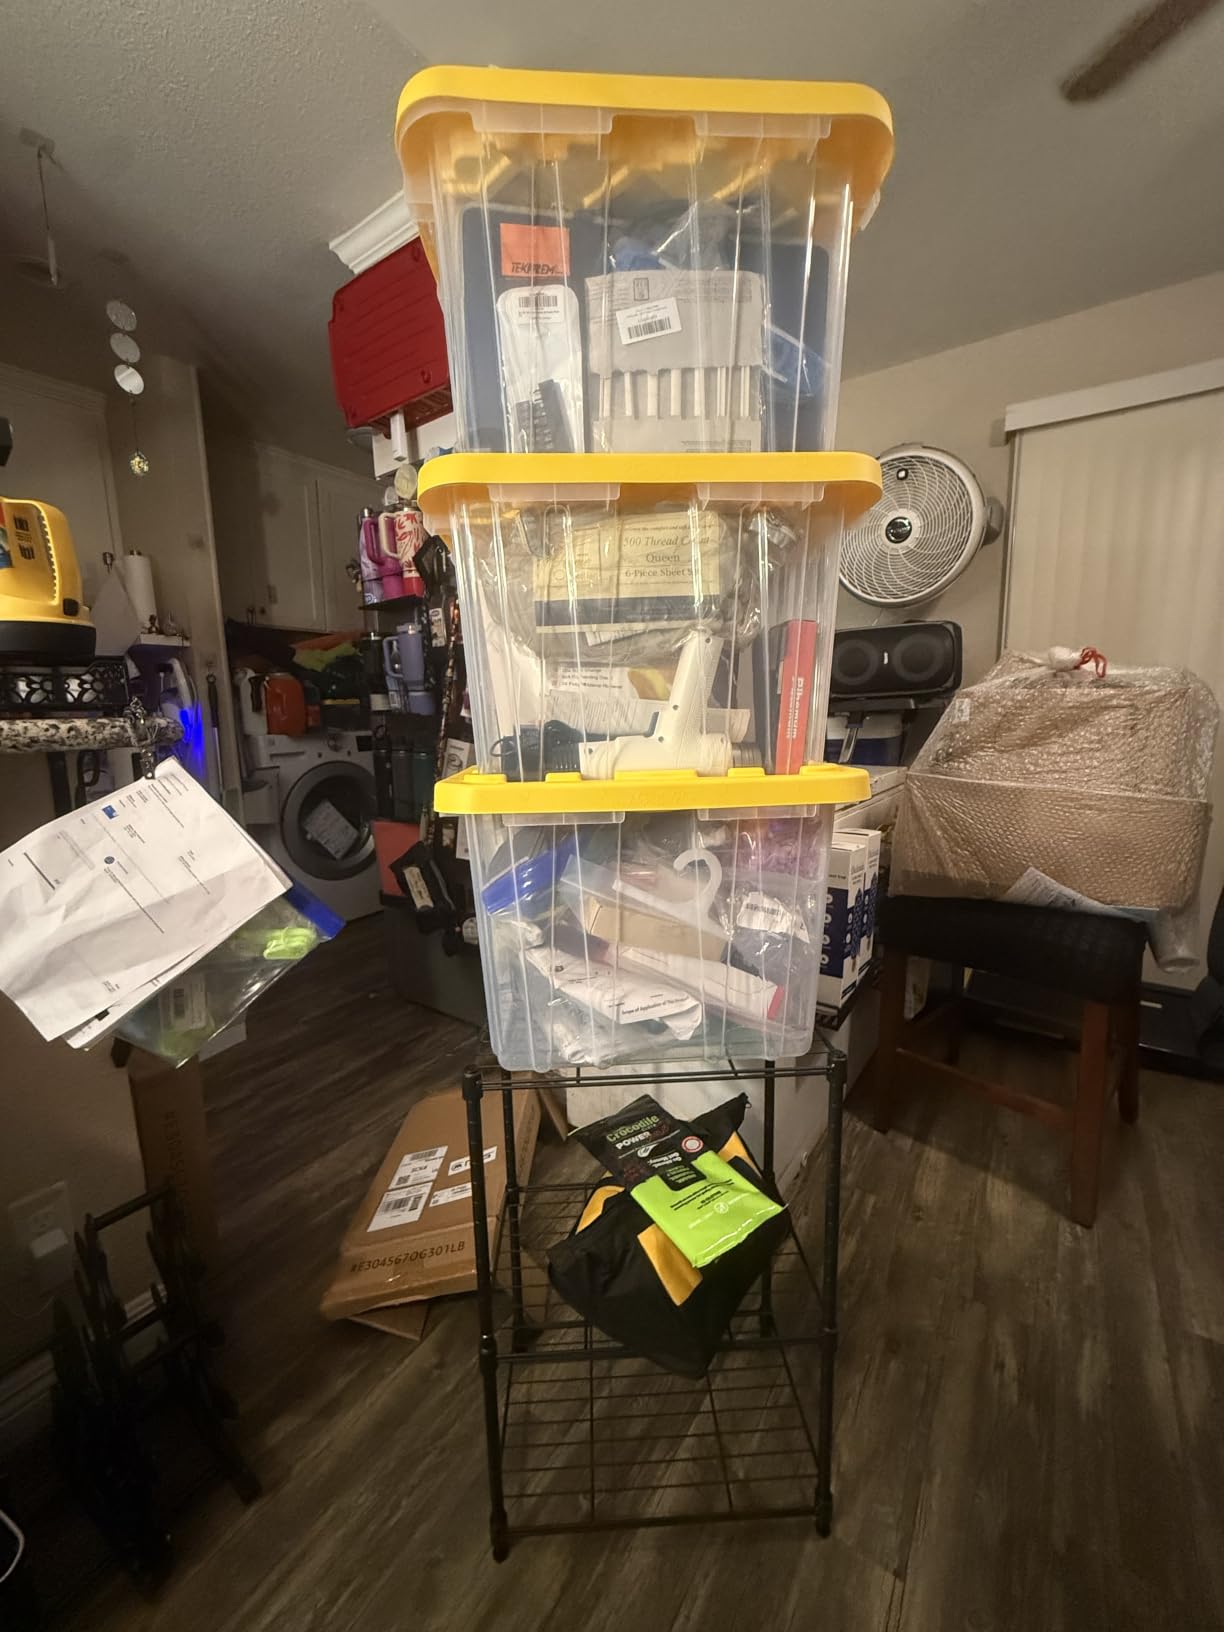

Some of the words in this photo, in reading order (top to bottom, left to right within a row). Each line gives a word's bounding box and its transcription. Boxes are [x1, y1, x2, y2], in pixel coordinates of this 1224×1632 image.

[644, 535, 679, 546] Thread
[645, 552, 680, 564] Queen
[660, 566, 685, 577] Sheet
[606, 1115, 660, 1142] Crocodile
[615, 1131, 652, 1150] POWER
